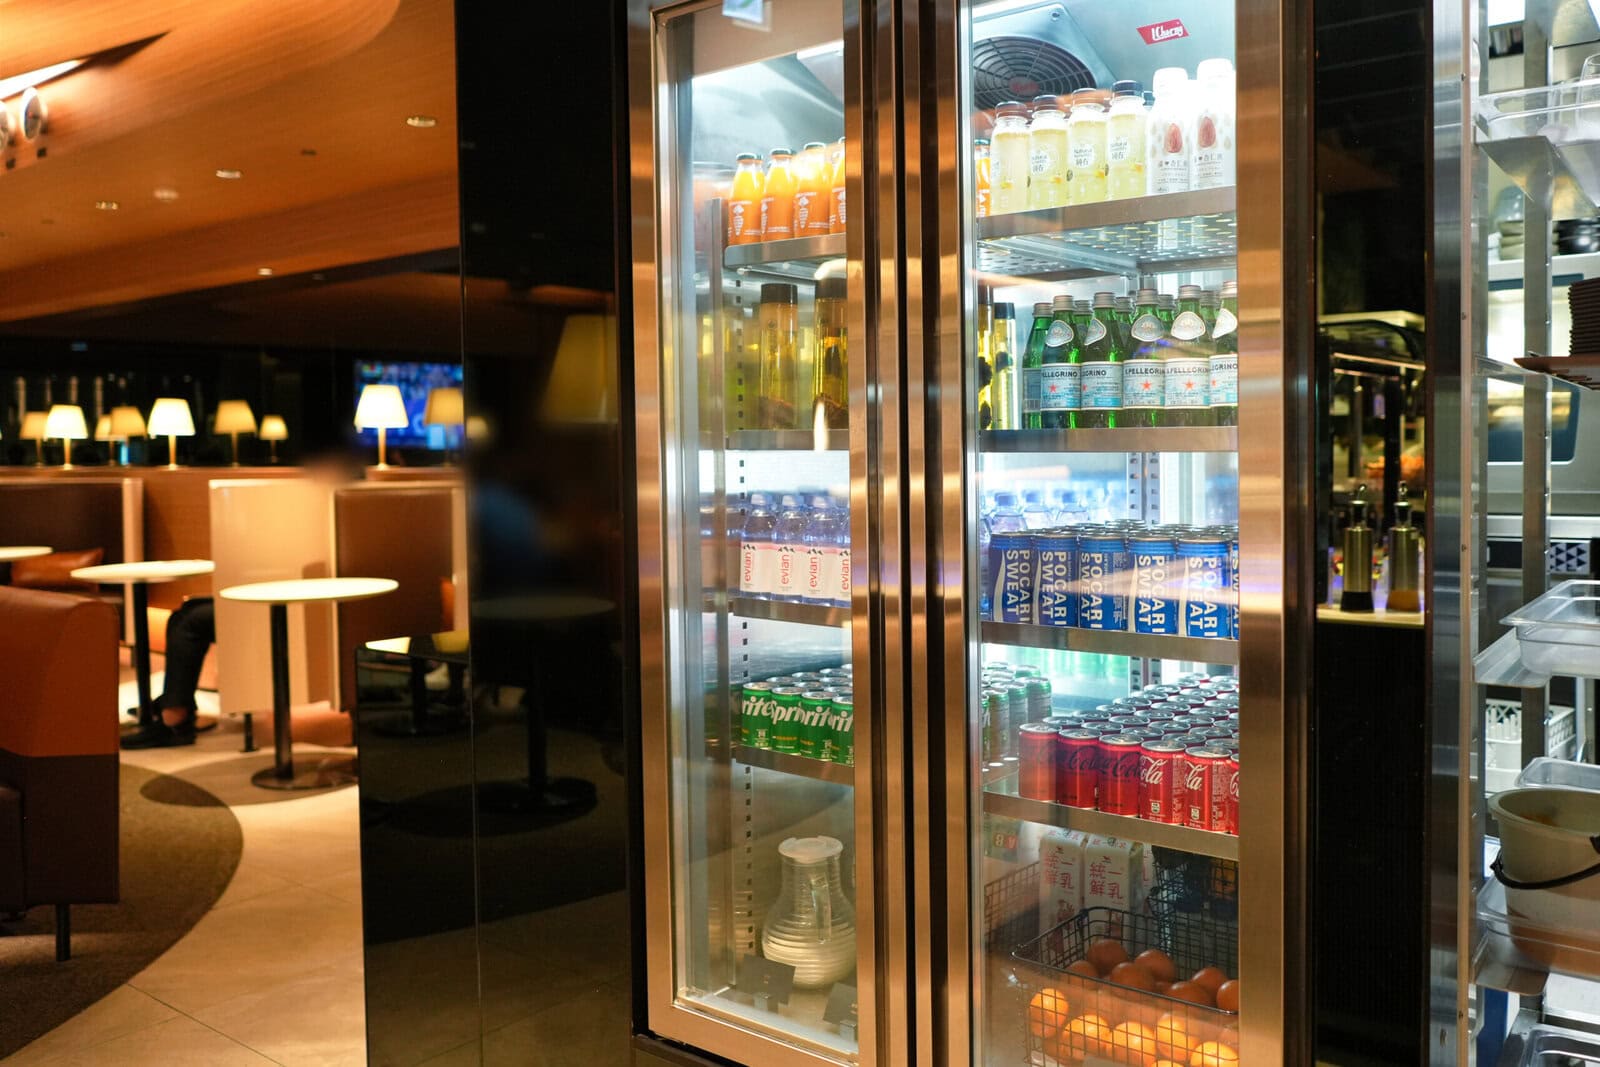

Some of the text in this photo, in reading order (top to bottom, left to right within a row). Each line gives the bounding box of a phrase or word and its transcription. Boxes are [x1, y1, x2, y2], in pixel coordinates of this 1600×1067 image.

[744, 552, 752, 582] evian
[780, 554, 790, 585] evian
[808, 556, 818, 588] evian
[841, 558, 850, 590] evian
[1006, 550, 1019, 616] SWEAT
[1019, 549, 1030, 622] POCARI
[1042, 551, 1054, 619] SWEAT
[1054, 551, 1067, 625] POCARI
[1081, 552, 1091, 621] SWEAT
[1090, 553, 1103, 628] POCARI
[1138, 555, 1152, 626] SWEAT
[1151, 555, 1165, 633] POCARI
[1189, 557, 1204, 630] SWEAT
[1203, 557, 1218, 637] POCARI
